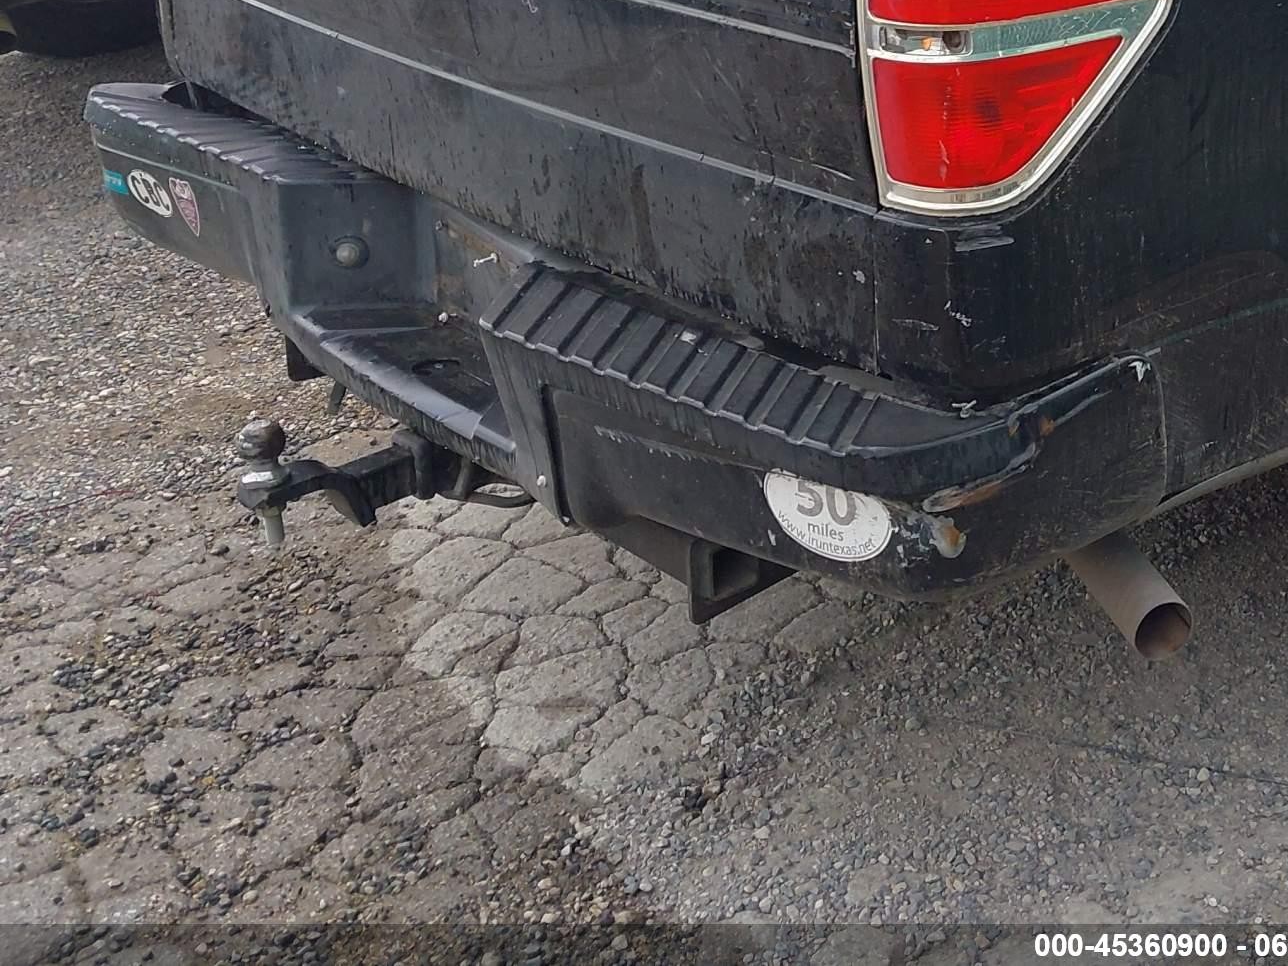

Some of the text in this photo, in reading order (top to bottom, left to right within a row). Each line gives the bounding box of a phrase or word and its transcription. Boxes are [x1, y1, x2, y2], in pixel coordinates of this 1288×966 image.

[796, 480, 858, 526] 50
[778, 509, 877, 555] www.iruntexas.net
[807, 522, 844, 542] miles
